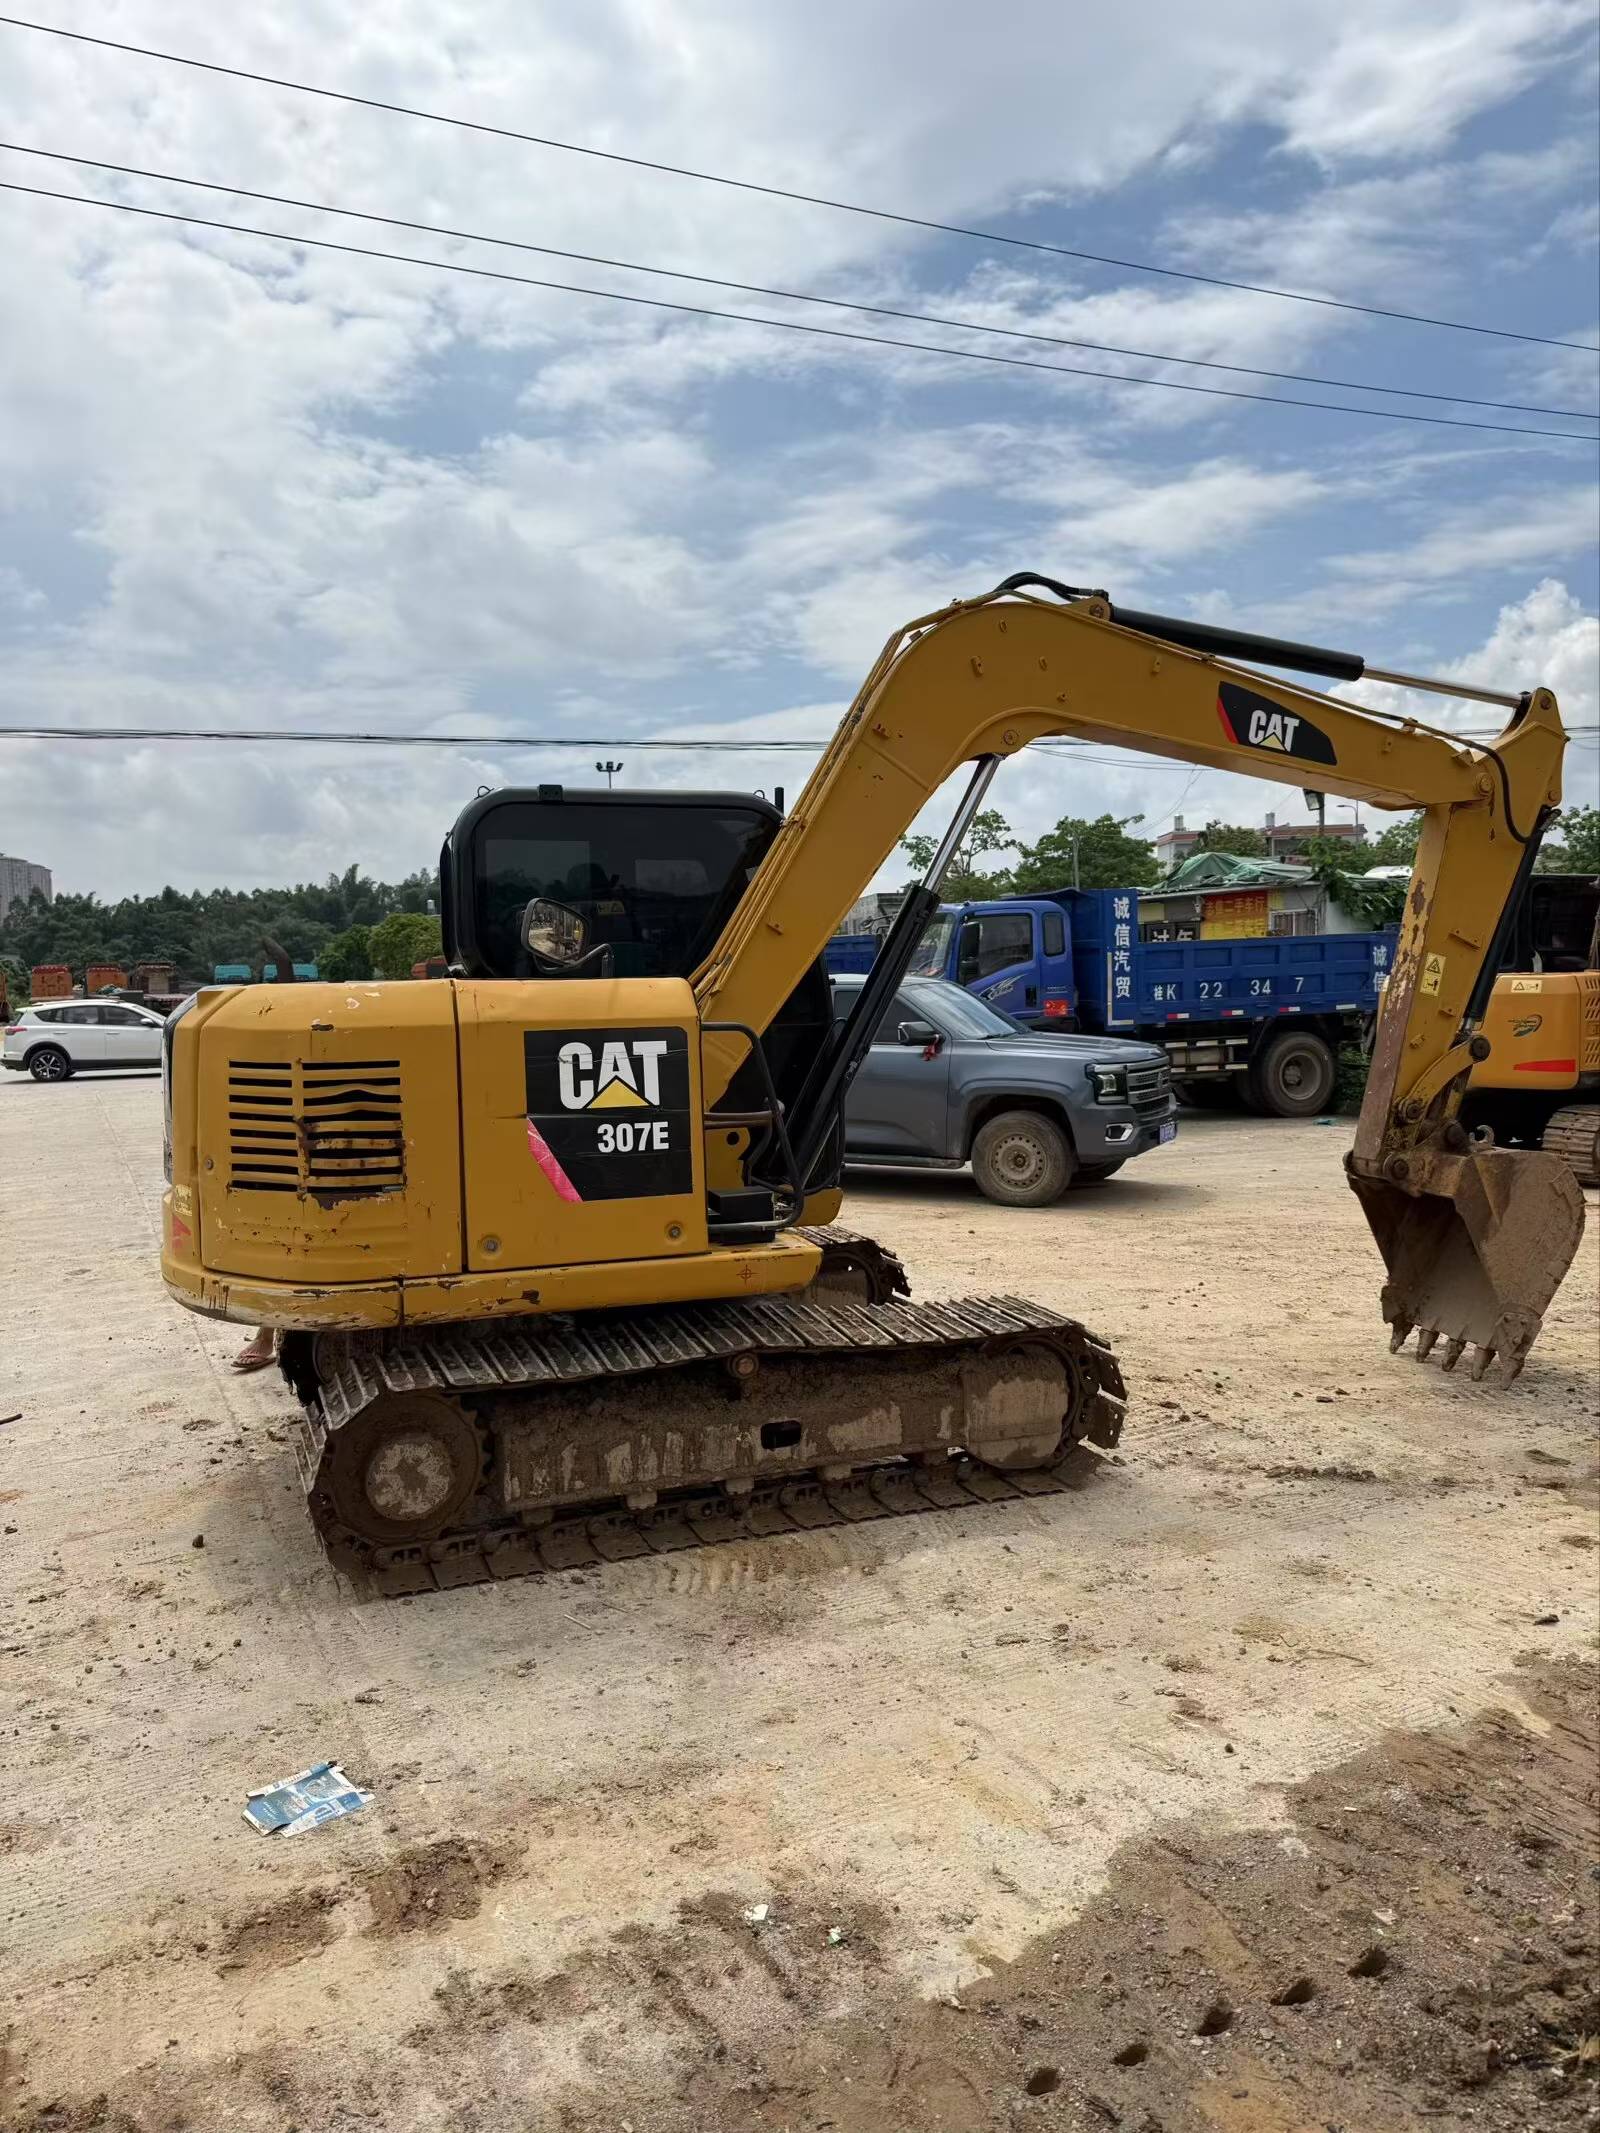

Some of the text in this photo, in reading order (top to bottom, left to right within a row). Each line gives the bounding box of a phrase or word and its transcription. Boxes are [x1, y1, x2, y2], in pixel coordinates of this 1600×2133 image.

[1248, 709, 1300, 752] CAT
[1113, 896, 1131, 998] 诚信汽贸
[1372, 944, 1388, 992] 诚信
[1199, 982, 1223, 999] 22
[1250, 979, 1272, 996] 34
[1294, 976, 1305, 993] 7
[558, 1040, 668, 1110] CAT
[597, 1121, 670, 1153] 307E
